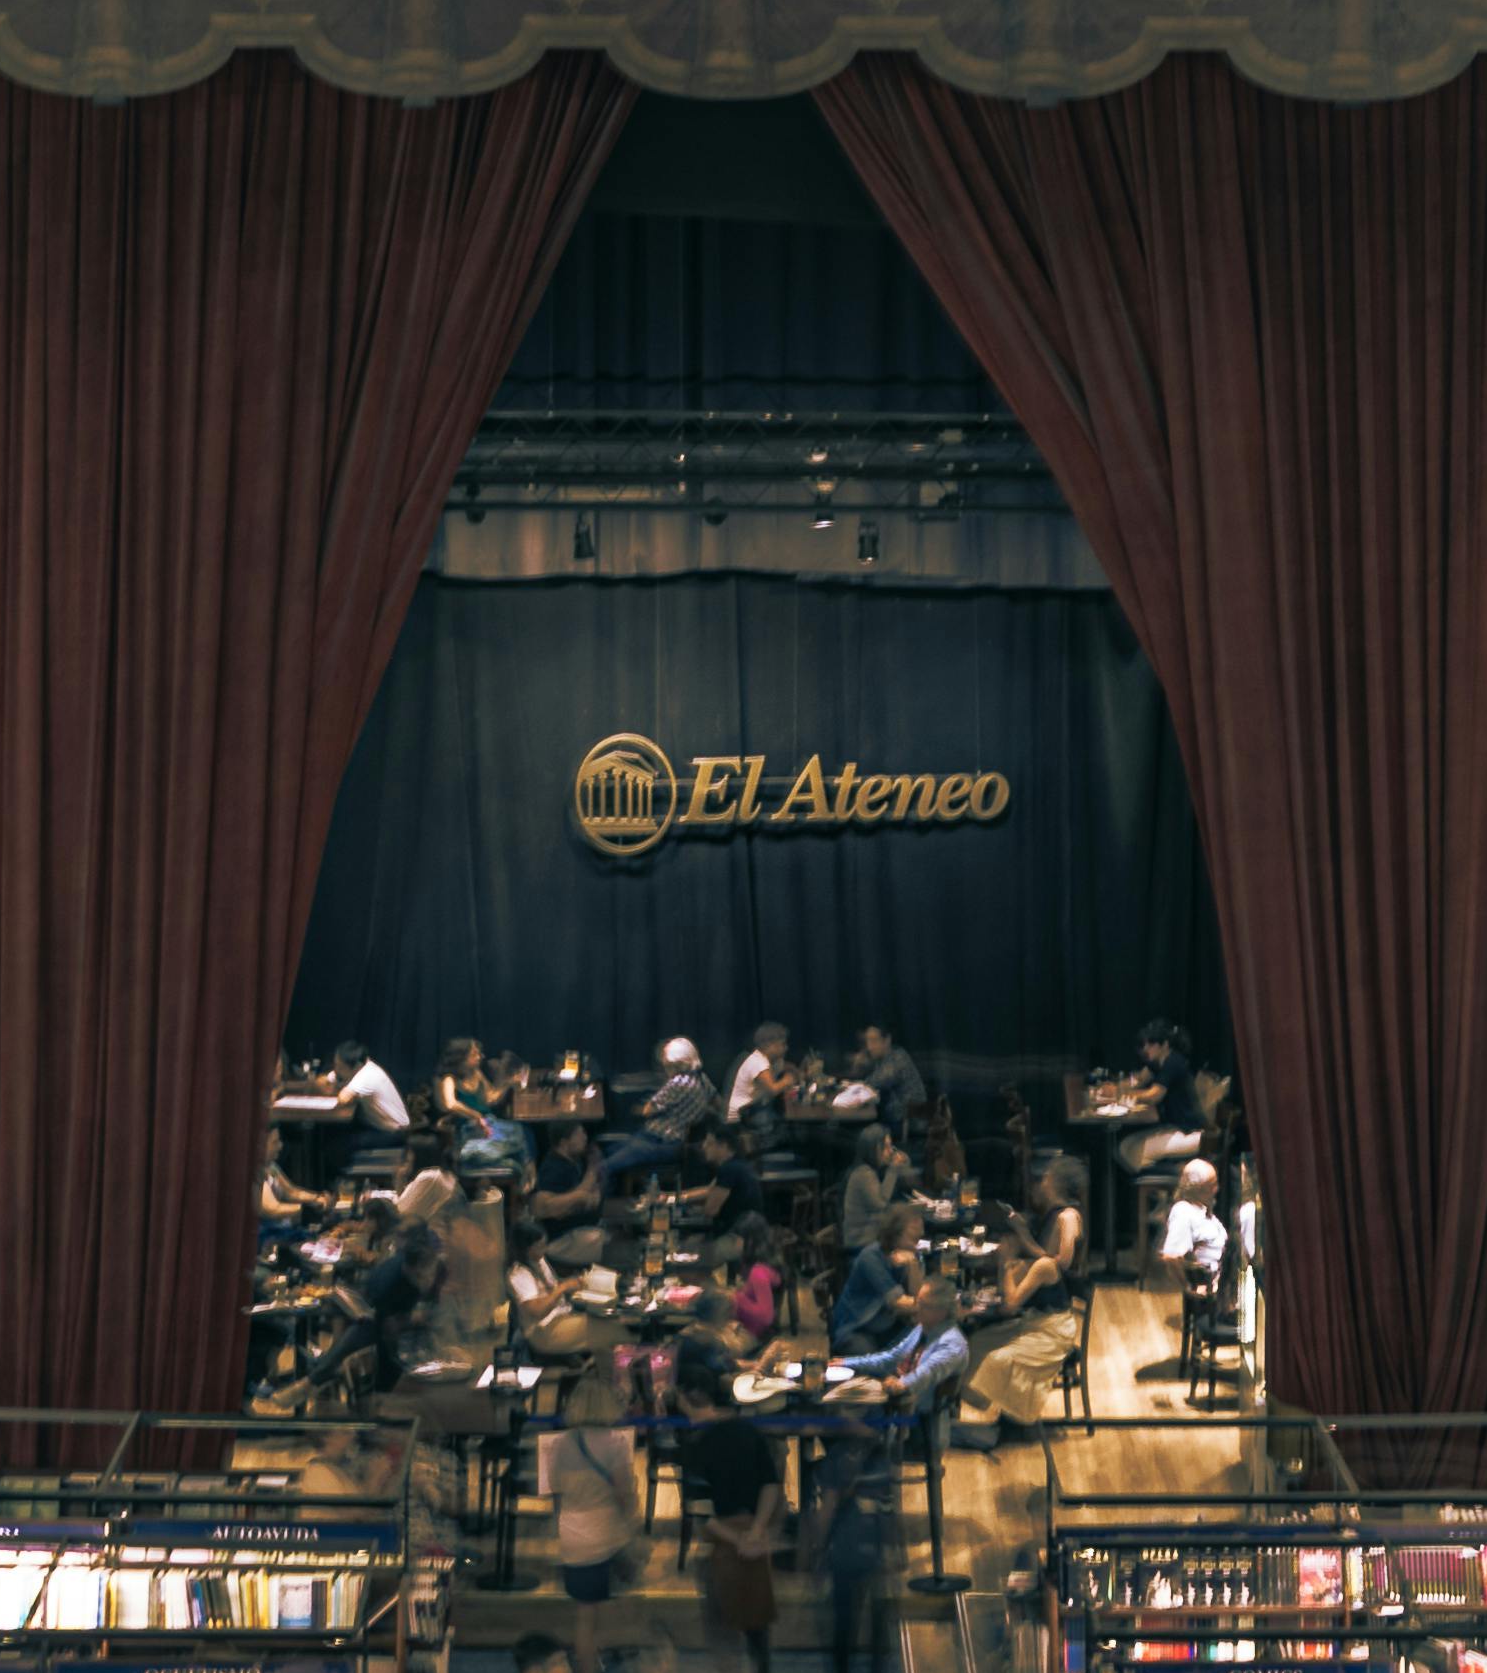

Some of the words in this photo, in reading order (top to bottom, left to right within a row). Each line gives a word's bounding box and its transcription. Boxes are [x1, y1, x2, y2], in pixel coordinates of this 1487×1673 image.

[679, 754, 766, 823] El
[771, 753, 1011, 822] Ateneo
[212, 1525, 319, 1542] AUTOAYUDA
